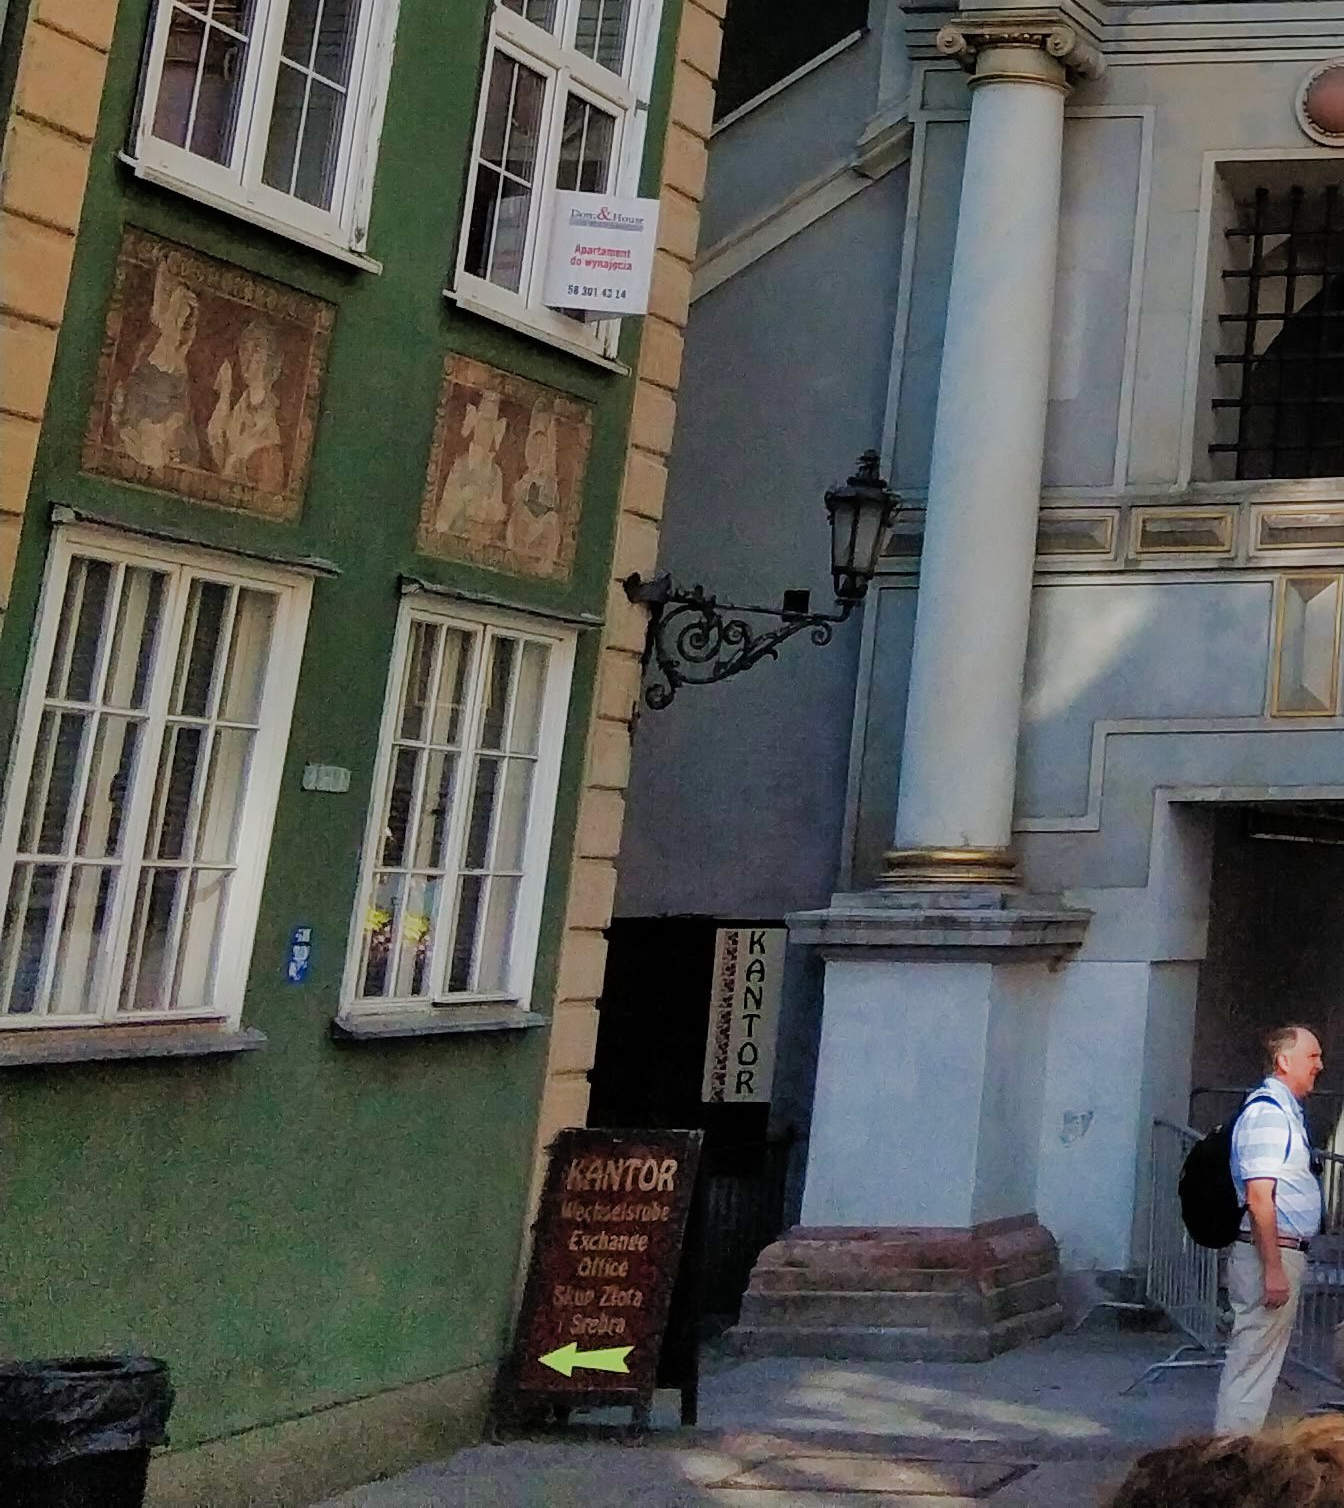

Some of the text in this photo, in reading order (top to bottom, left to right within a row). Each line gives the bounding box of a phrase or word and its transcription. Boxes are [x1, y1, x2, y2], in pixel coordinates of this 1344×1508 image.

[596, 206, 612, 221] &
[612, 212, 645, 224] House
[570, 255, 582, 266] do
[574, 243, 632, 258] Apartament
[567, 284, 579, 295] 58
[581, 285, 598, 297] 301
[615, 289, 626, 299] 14
[735, 930, 766, 1094] KANTOR
[566, 1157, 679, 1192] KANTOR
[568, 1229, 650, 1253] Exchange
[576, 1255, 630, 1278] Office
